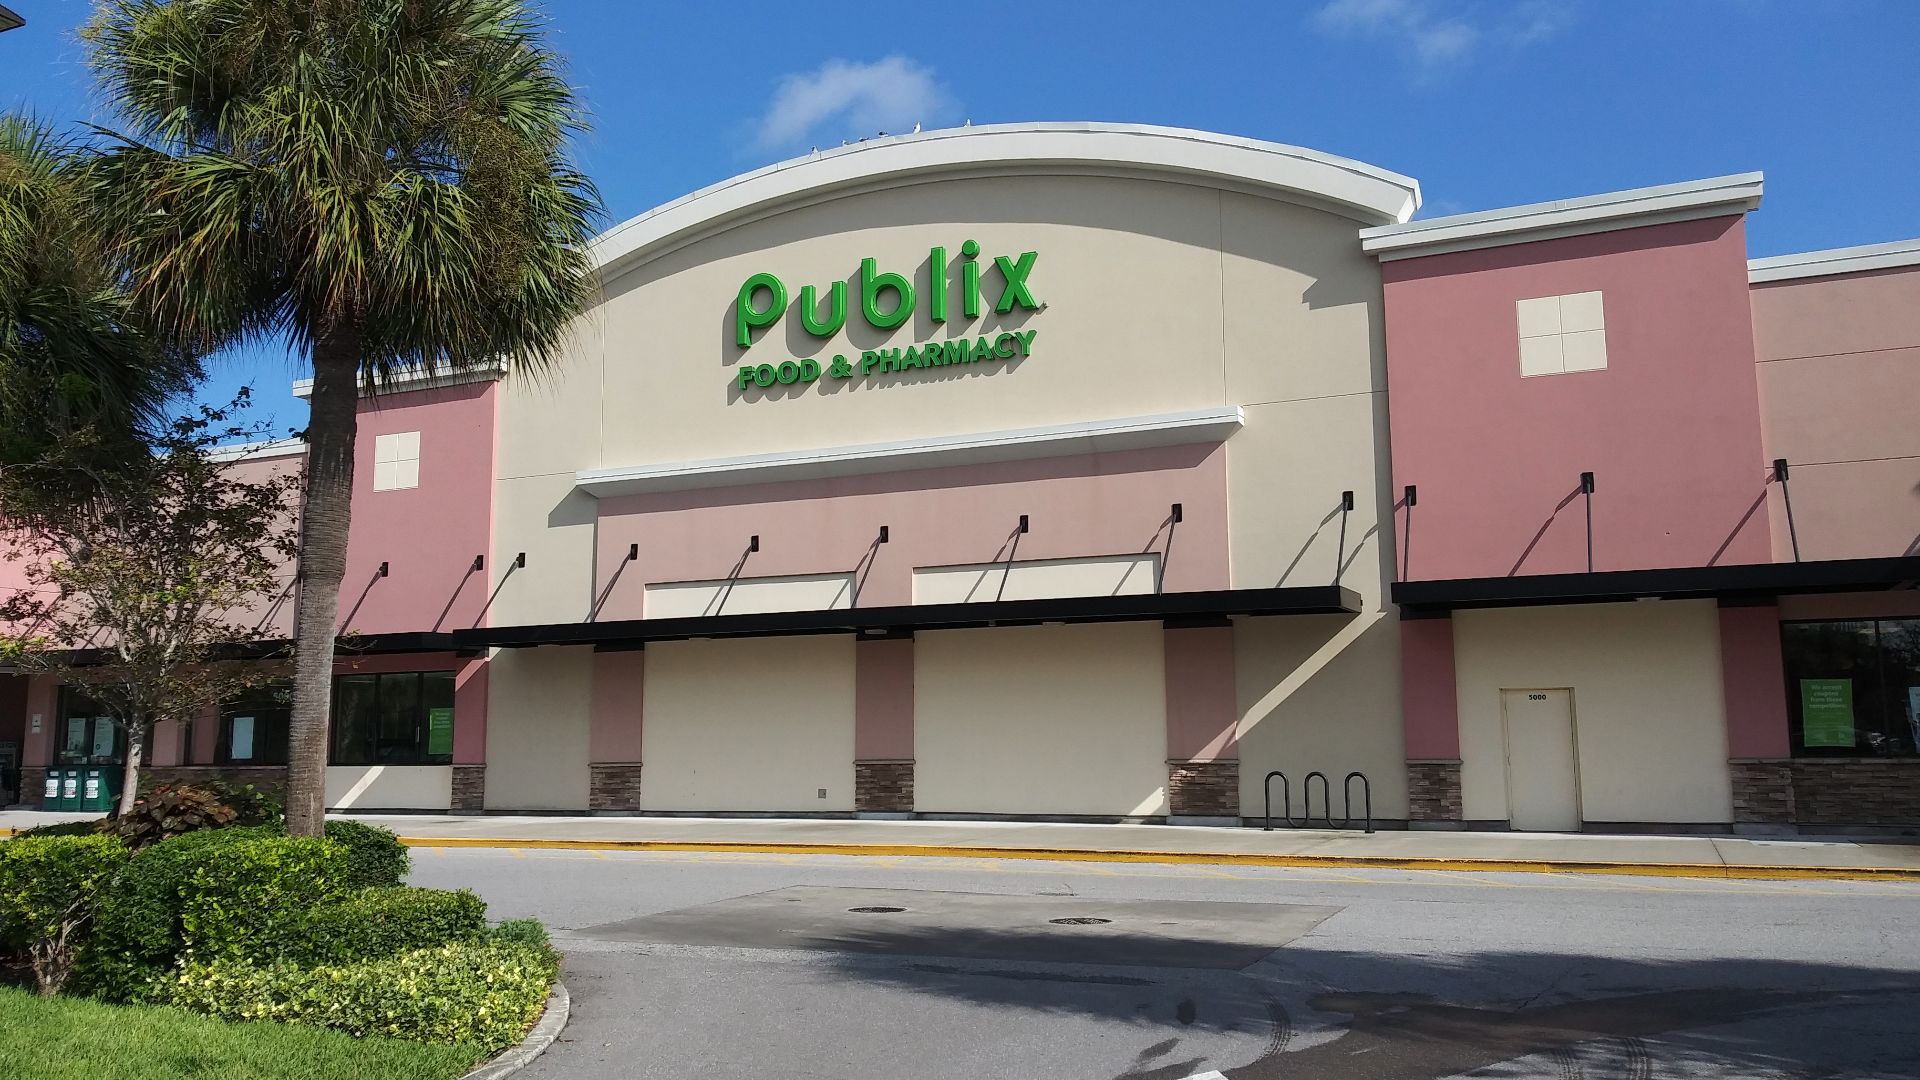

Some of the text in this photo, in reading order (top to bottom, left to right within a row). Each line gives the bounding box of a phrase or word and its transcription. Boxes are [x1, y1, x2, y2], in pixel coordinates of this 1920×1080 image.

[739, 330, 1038, 390] FOOD & PHARMACY
